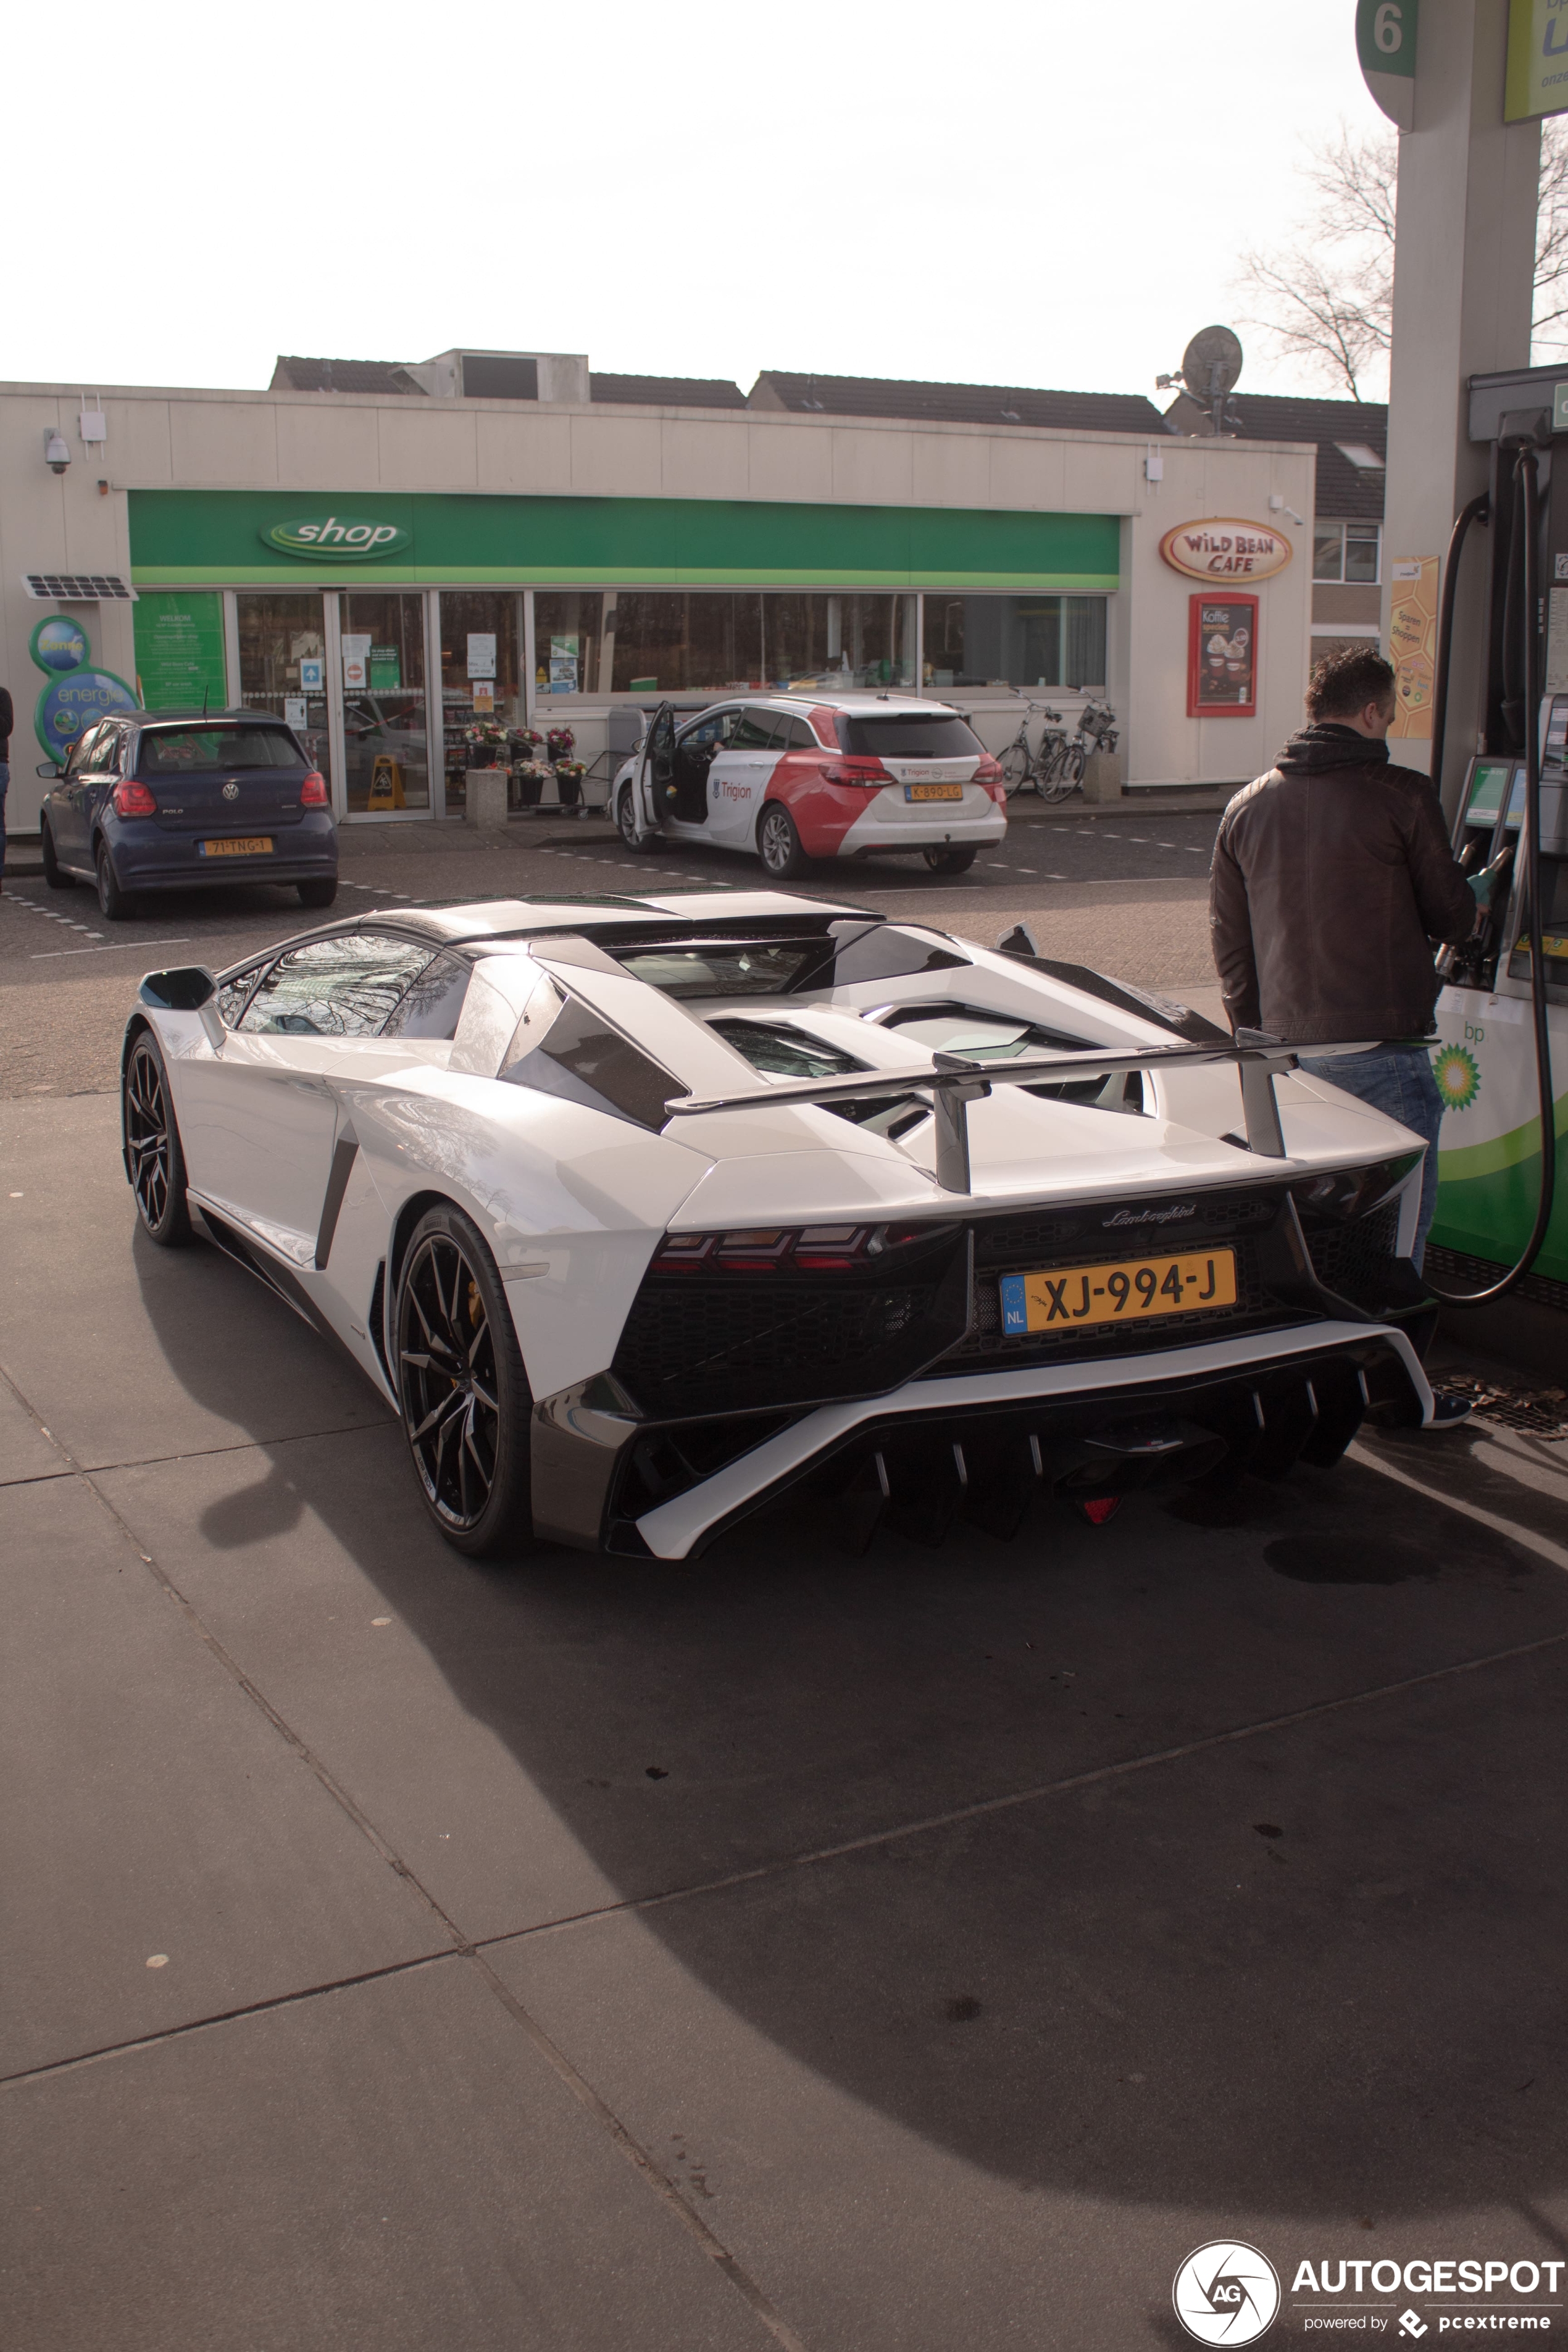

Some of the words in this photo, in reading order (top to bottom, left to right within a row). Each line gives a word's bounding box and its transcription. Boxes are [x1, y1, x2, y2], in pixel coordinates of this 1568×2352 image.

[1374, 2, 1402, 54] 6
[1541, 71, 1568, 88] onze
[298, 517, 397, 551] shop
[1235, 536, 1274, 554] BEAN
[1207, 555, 1253, 572] CAFE
[1203, 611, 1230, 623] Koffie
[1398, 611, 1421, 627] Sparen
[1391, 626, 1420, 644] Shoppen
[41, 640, 83, 651] Zonne
[58, 687, 124, 706] energie
[722, 782, 751, 801] Trigion
[914, 786, 959, 798] K-890-LG
[212, 840, 264, 853] 71-TNG-1
[1464, 1020, 1485, 1046] bp
[1102, 1204, 1196, 1227] Lamborghini
[1007, 1311, 1024, 1324] NL
[1045, 1260, 1216, 1321] XJ-994-J
[417, 1457, 425, 1471] APP
[423, 1472, 433, 1491] TECH
